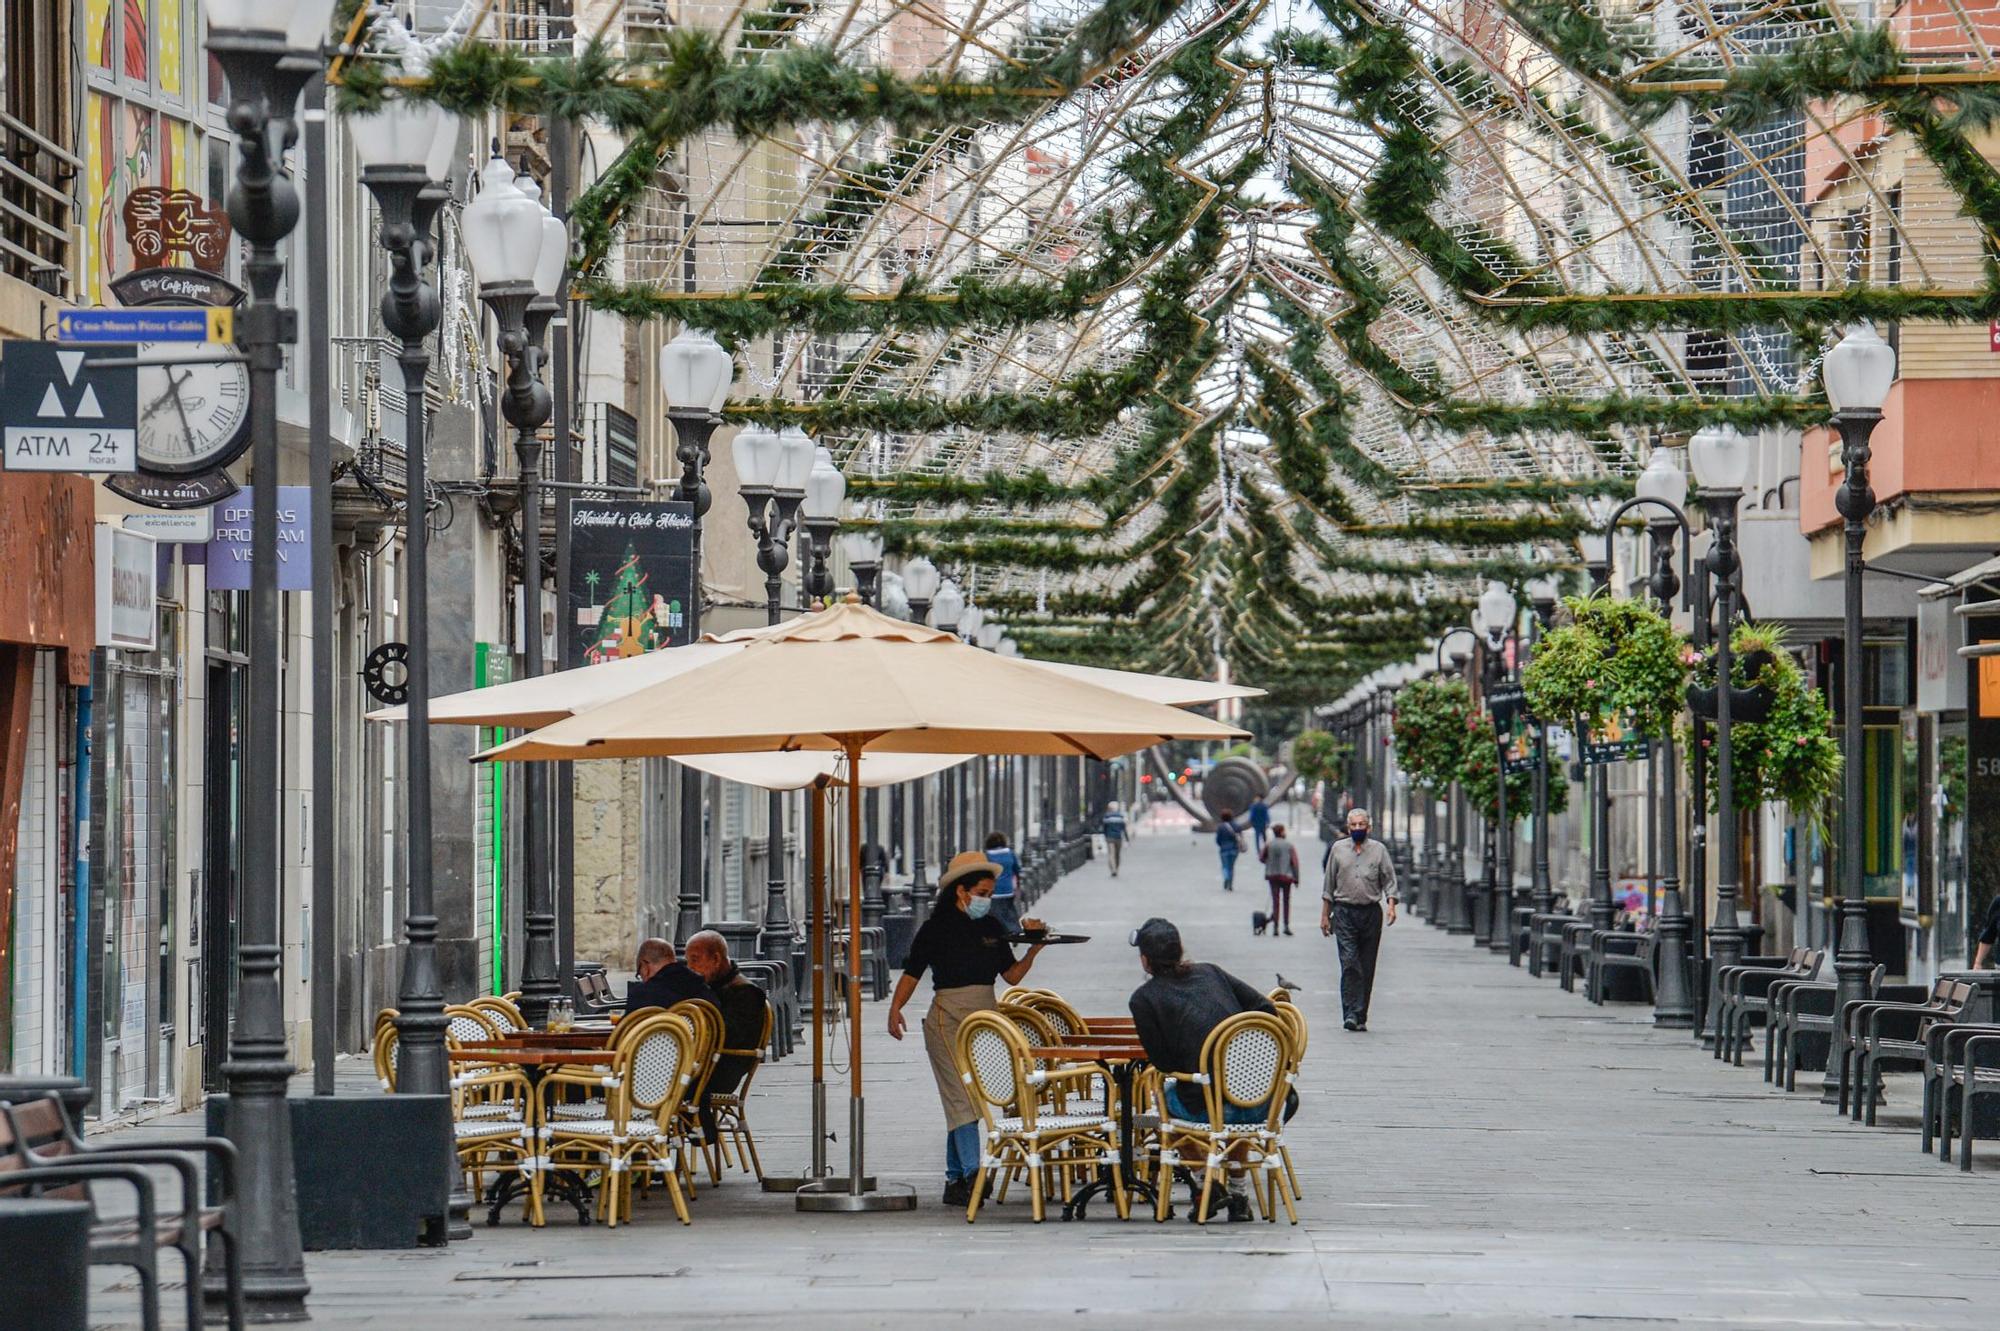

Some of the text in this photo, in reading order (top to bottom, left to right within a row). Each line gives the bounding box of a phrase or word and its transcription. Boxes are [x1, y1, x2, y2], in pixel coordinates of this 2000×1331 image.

[16, 432, 119, 456] ATM 24
[88, 453, 117, 465] horas
[141, 488, 199, 498] BAR & GRILL
[144, 519, 196, 528] excellence
[573, 510, 693, 528] Navidad a Cielo Abierto
[216, 528, 305, 543] PROAM
[1976, 757, 2000, 776] 58
